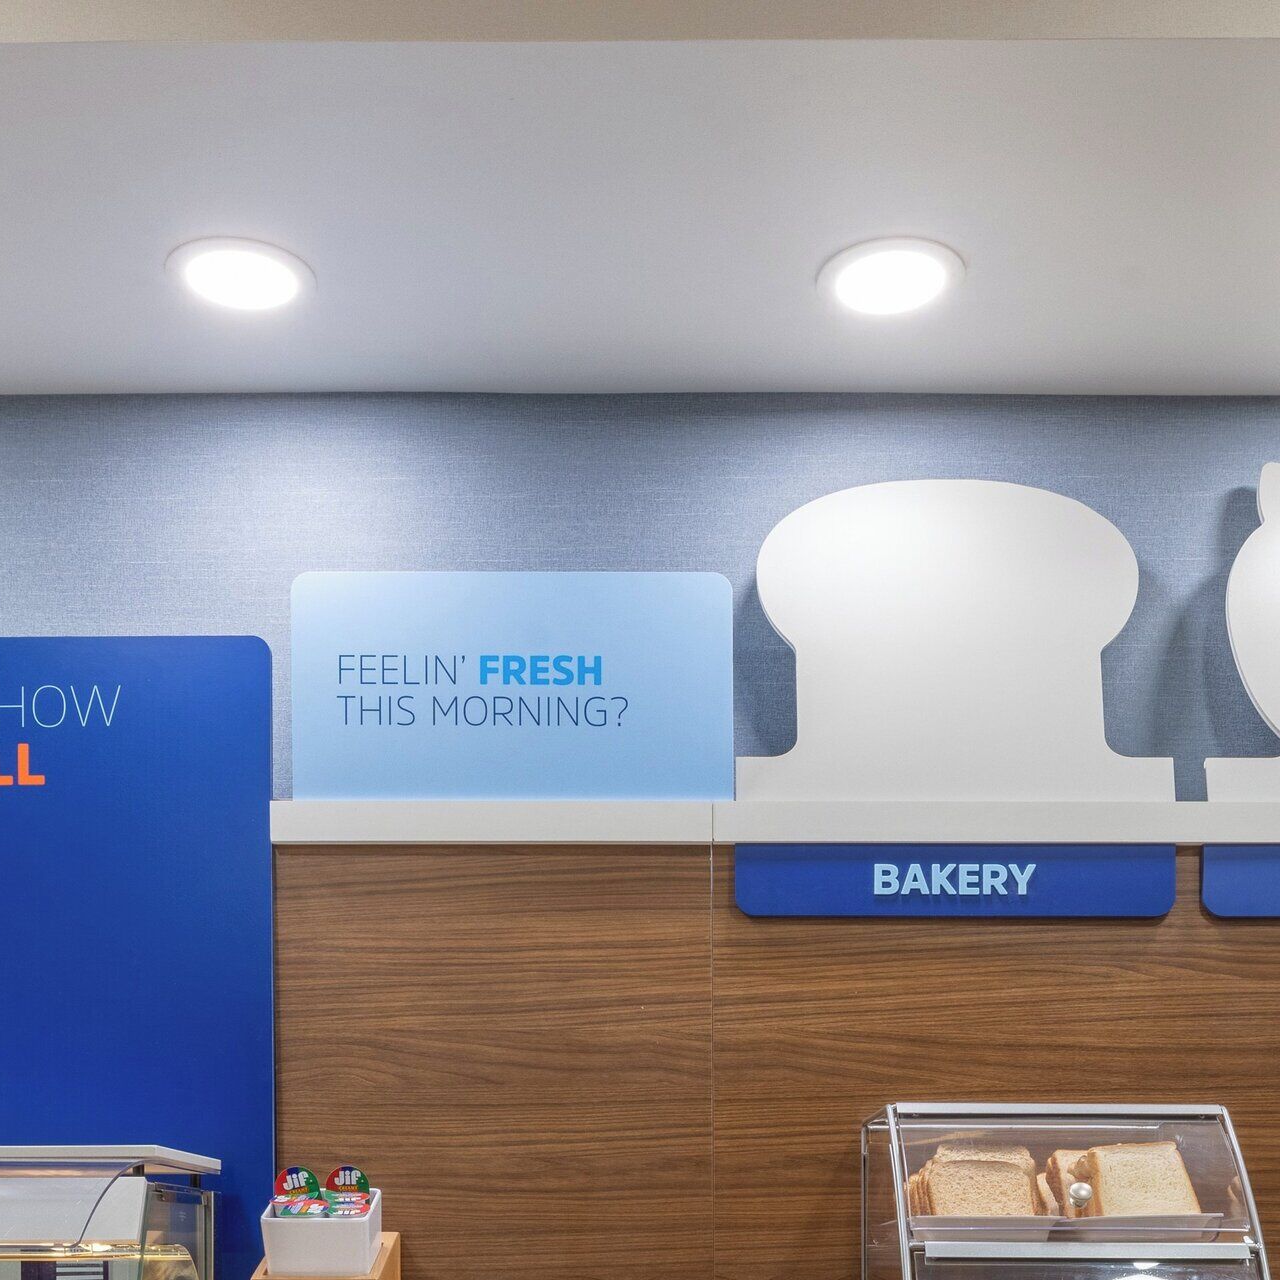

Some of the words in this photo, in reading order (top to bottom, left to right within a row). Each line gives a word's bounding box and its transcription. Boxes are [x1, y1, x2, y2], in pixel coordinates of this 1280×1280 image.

[479, 654, 603, 686] FRESH
[336, 695, 416, 726] THIS
[431, 695, 630, 728] MORNING?
[872, 863, 1037, 896] BAKERY
[282, 1170, 309, 1191] Jif
[333, 1169, 362, 1186] Jif
